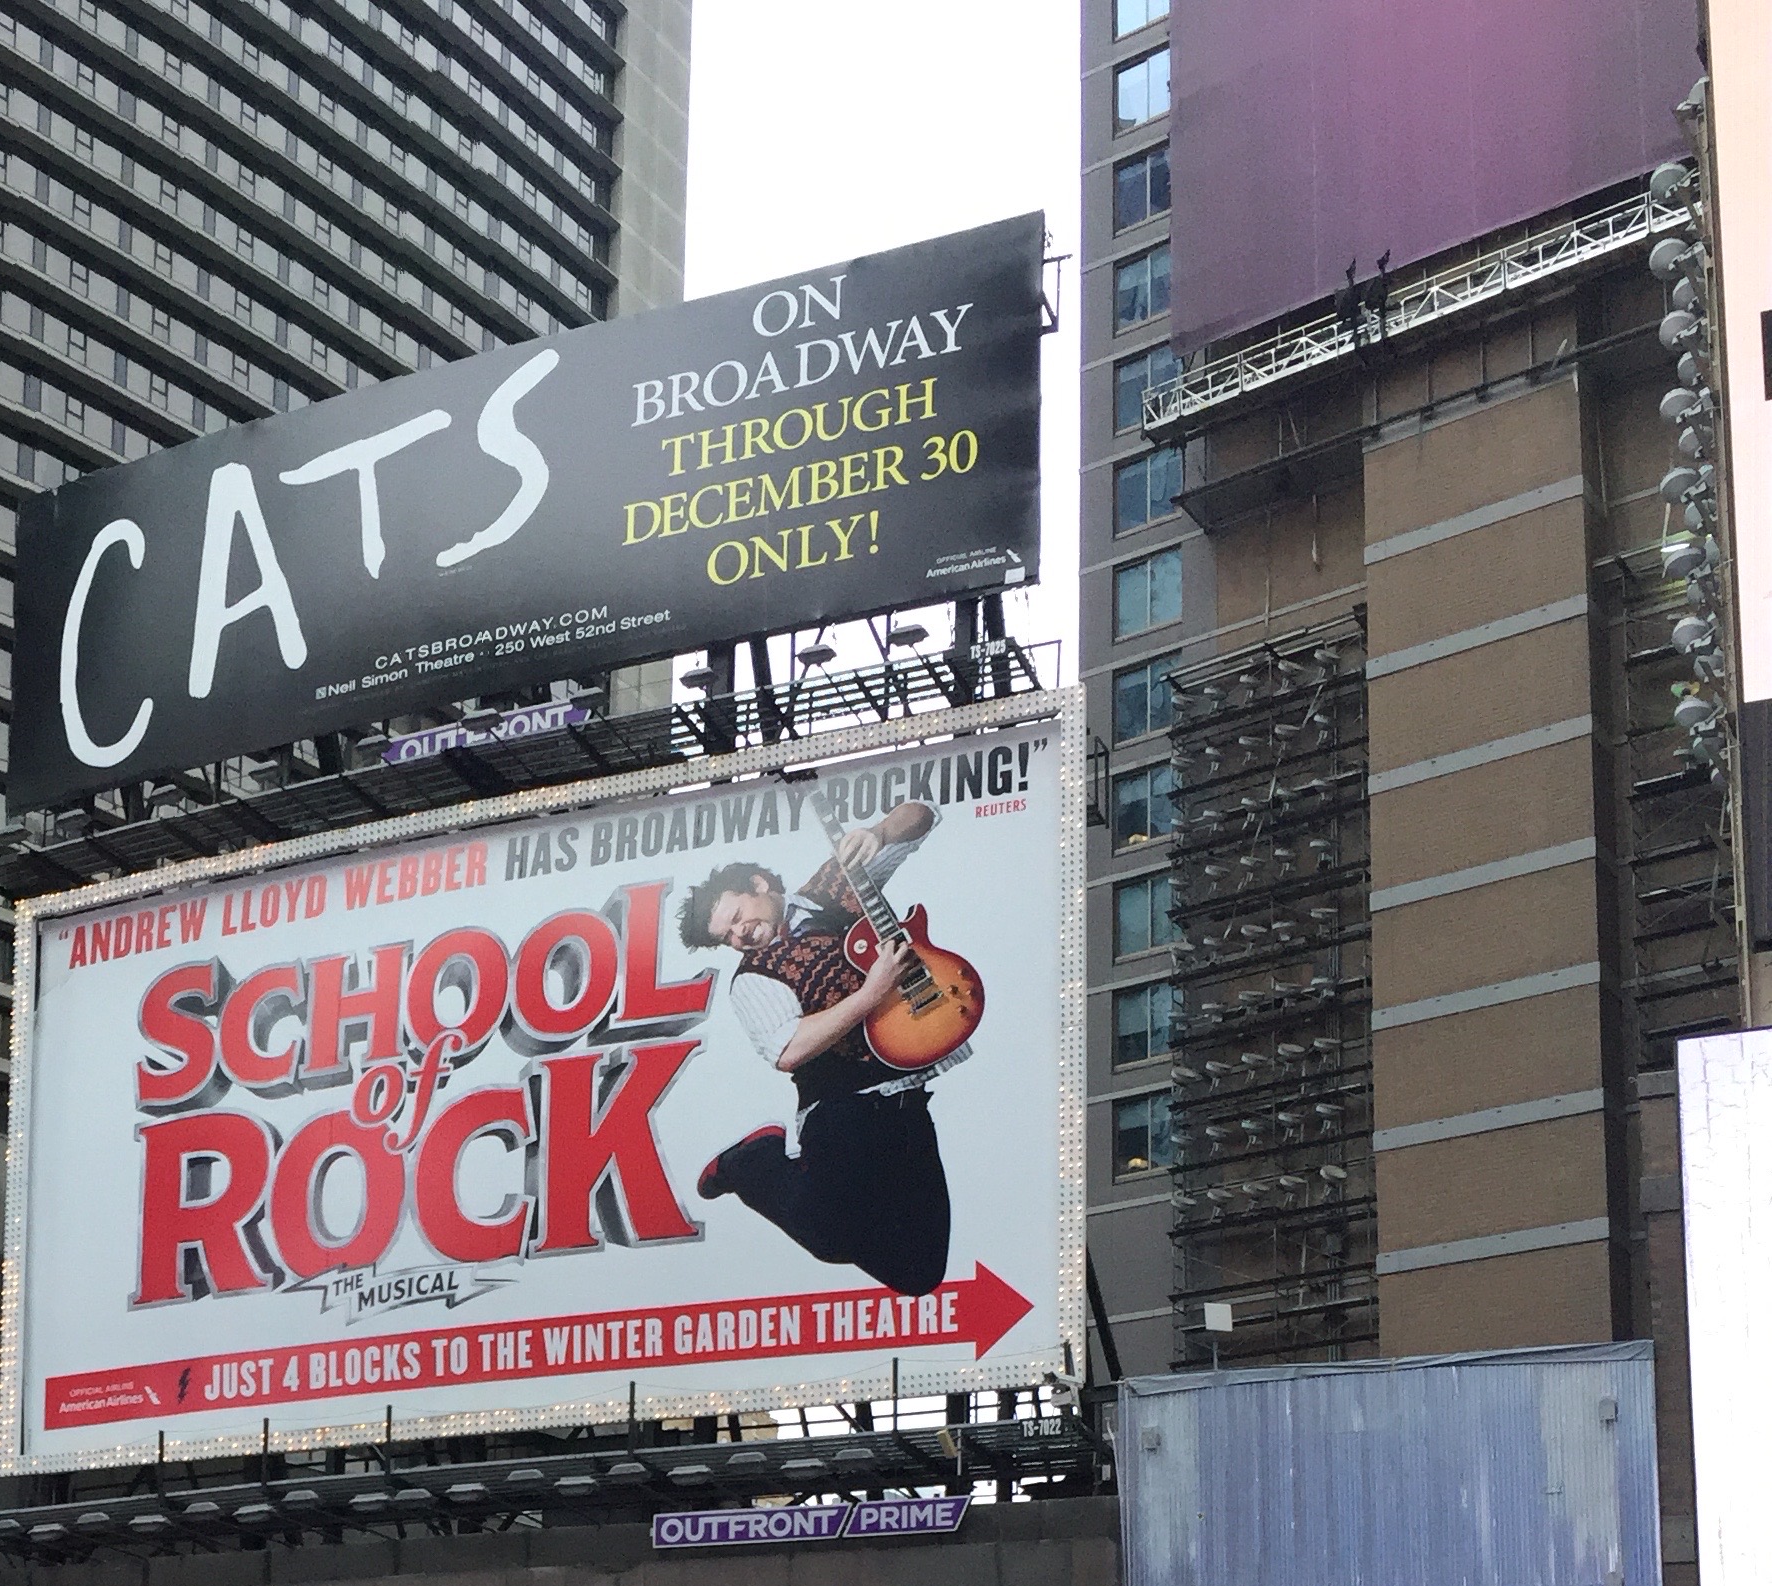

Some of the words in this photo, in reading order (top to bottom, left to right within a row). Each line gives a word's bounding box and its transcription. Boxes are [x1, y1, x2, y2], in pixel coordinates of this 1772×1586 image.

[751, 275, 847, 339] ON
[632, 305, 971, 428] BROADWAY
[663, 378, 937, 477] THROUGH
[623, 449, 910, 546] DECEMBER
[920, 429, 978, 484] 30
[62, 348, 560, 769] CATS
[706, 511, 881, 587] ONLY!
[328, 680, 356, 697] Neil
[361, 668, 408, 689] Simon
[416, 652, 474, 674] Theatre
[495, 639, 524, 656] 250
[530, 633, 571, 649] West
[575, 622, 615, 642] 52nd
[620, 609, 671, 629] Street
[970, 639, 1006, 659] TS-7025
[975, 799, 1027, 819] REUTERS
[135, 878, 719, 1112] SCHOOL
[128, 1036, 706, 1313] ROCK
[333, 1272, 364, 1297] THE
[358, 1271, 459, 1312] MUSICAL
[205, 1358, 274, 1401] JUST
[284, 1358, 298, 1392] 4
[309, 1342, 421, 1389] BLOCKS
[431, 1337, 468, 1374] TO
[478, 1330, 533, 1370] THE
[543, 1307, 664, 1364] WINTER
[673, 1300, 804, 1354] GARDEN
[813, 1289, 959, 1339] THEATRE
[1021, 1418, 1062, 1437] TS-7022
[660, 1506, 842, 1545] OUTFRONT
[858, 1497, 962, 1536] PRIME
